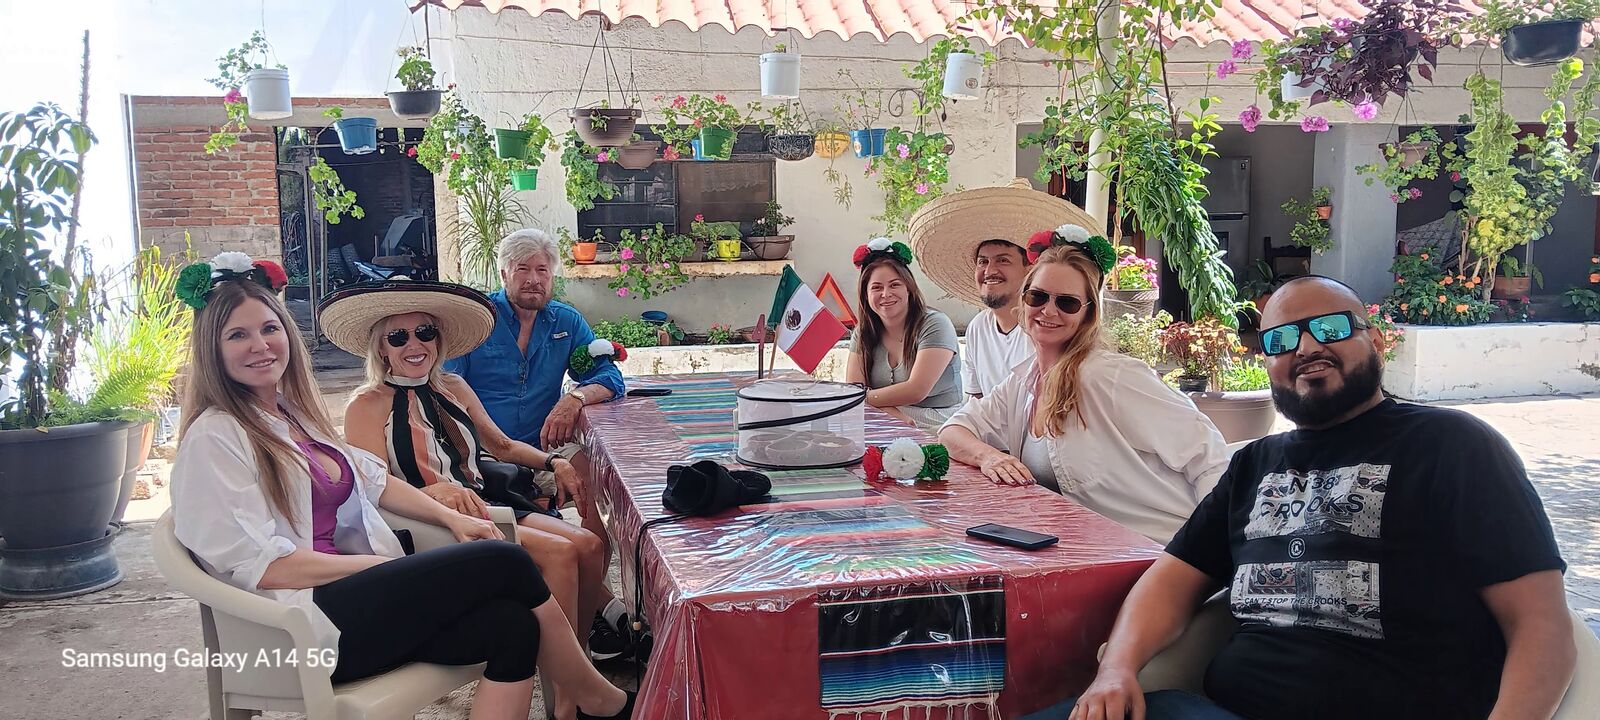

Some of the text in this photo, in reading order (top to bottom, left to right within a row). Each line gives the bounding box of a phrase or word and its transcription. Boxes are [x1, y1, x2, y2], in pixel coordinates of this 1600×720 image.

[1260, 494, 1364, 519] CROOKS
[1268, 597, 1288, 605] STOP
[1290, 597, 1305, 605] THE
[1308, 597, 1347, 605] CROOKS
